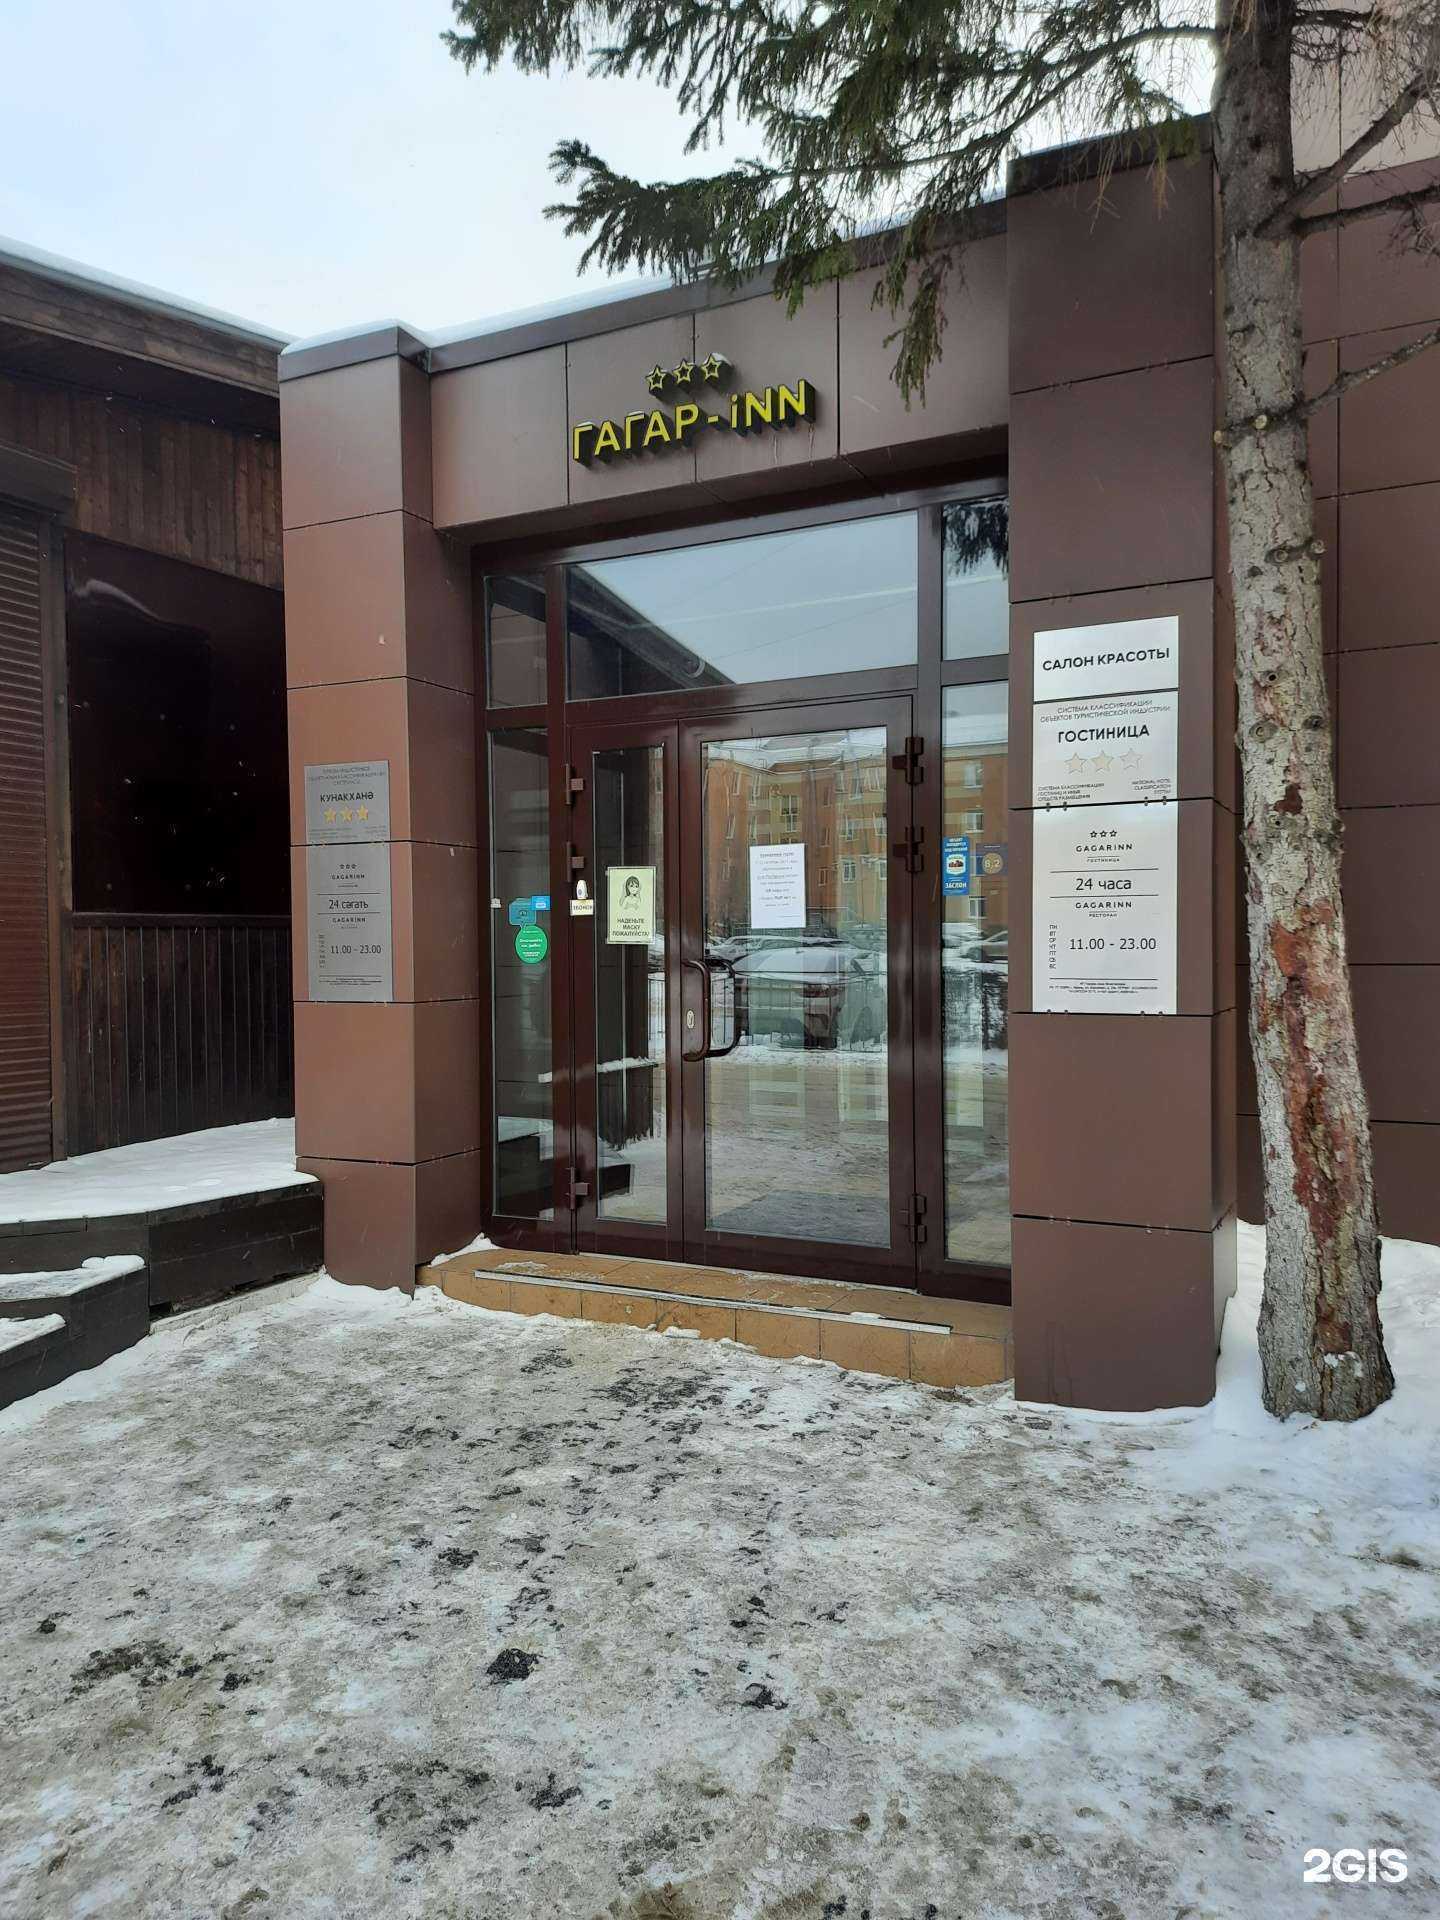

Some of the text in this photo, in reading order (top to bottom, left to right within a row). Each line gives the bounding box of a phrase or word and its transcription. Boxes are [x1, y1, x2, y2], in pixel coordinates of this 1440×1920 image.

[1042, 647, 1170, 671] САЛОН КРАСОТЫ
[1058, 725, 1150, 744] ГОСТИНИЦА
[320, 791, 374, 802] КУНАКХАНӘ
[1075, 843, 1133, 853] GAGARINN
[1075, 878, 1132, 891] 24 часа
[329, 899, 339, 910] 24
[1075, 901, 1132, 909] GAGARINN
[330, 945, 352, 954] 11.00
[359, 944, 382, 954] 23.00
[1069, 938, 1105, 950] 11.00
[1119, 938, 1157, 950] 23.00
